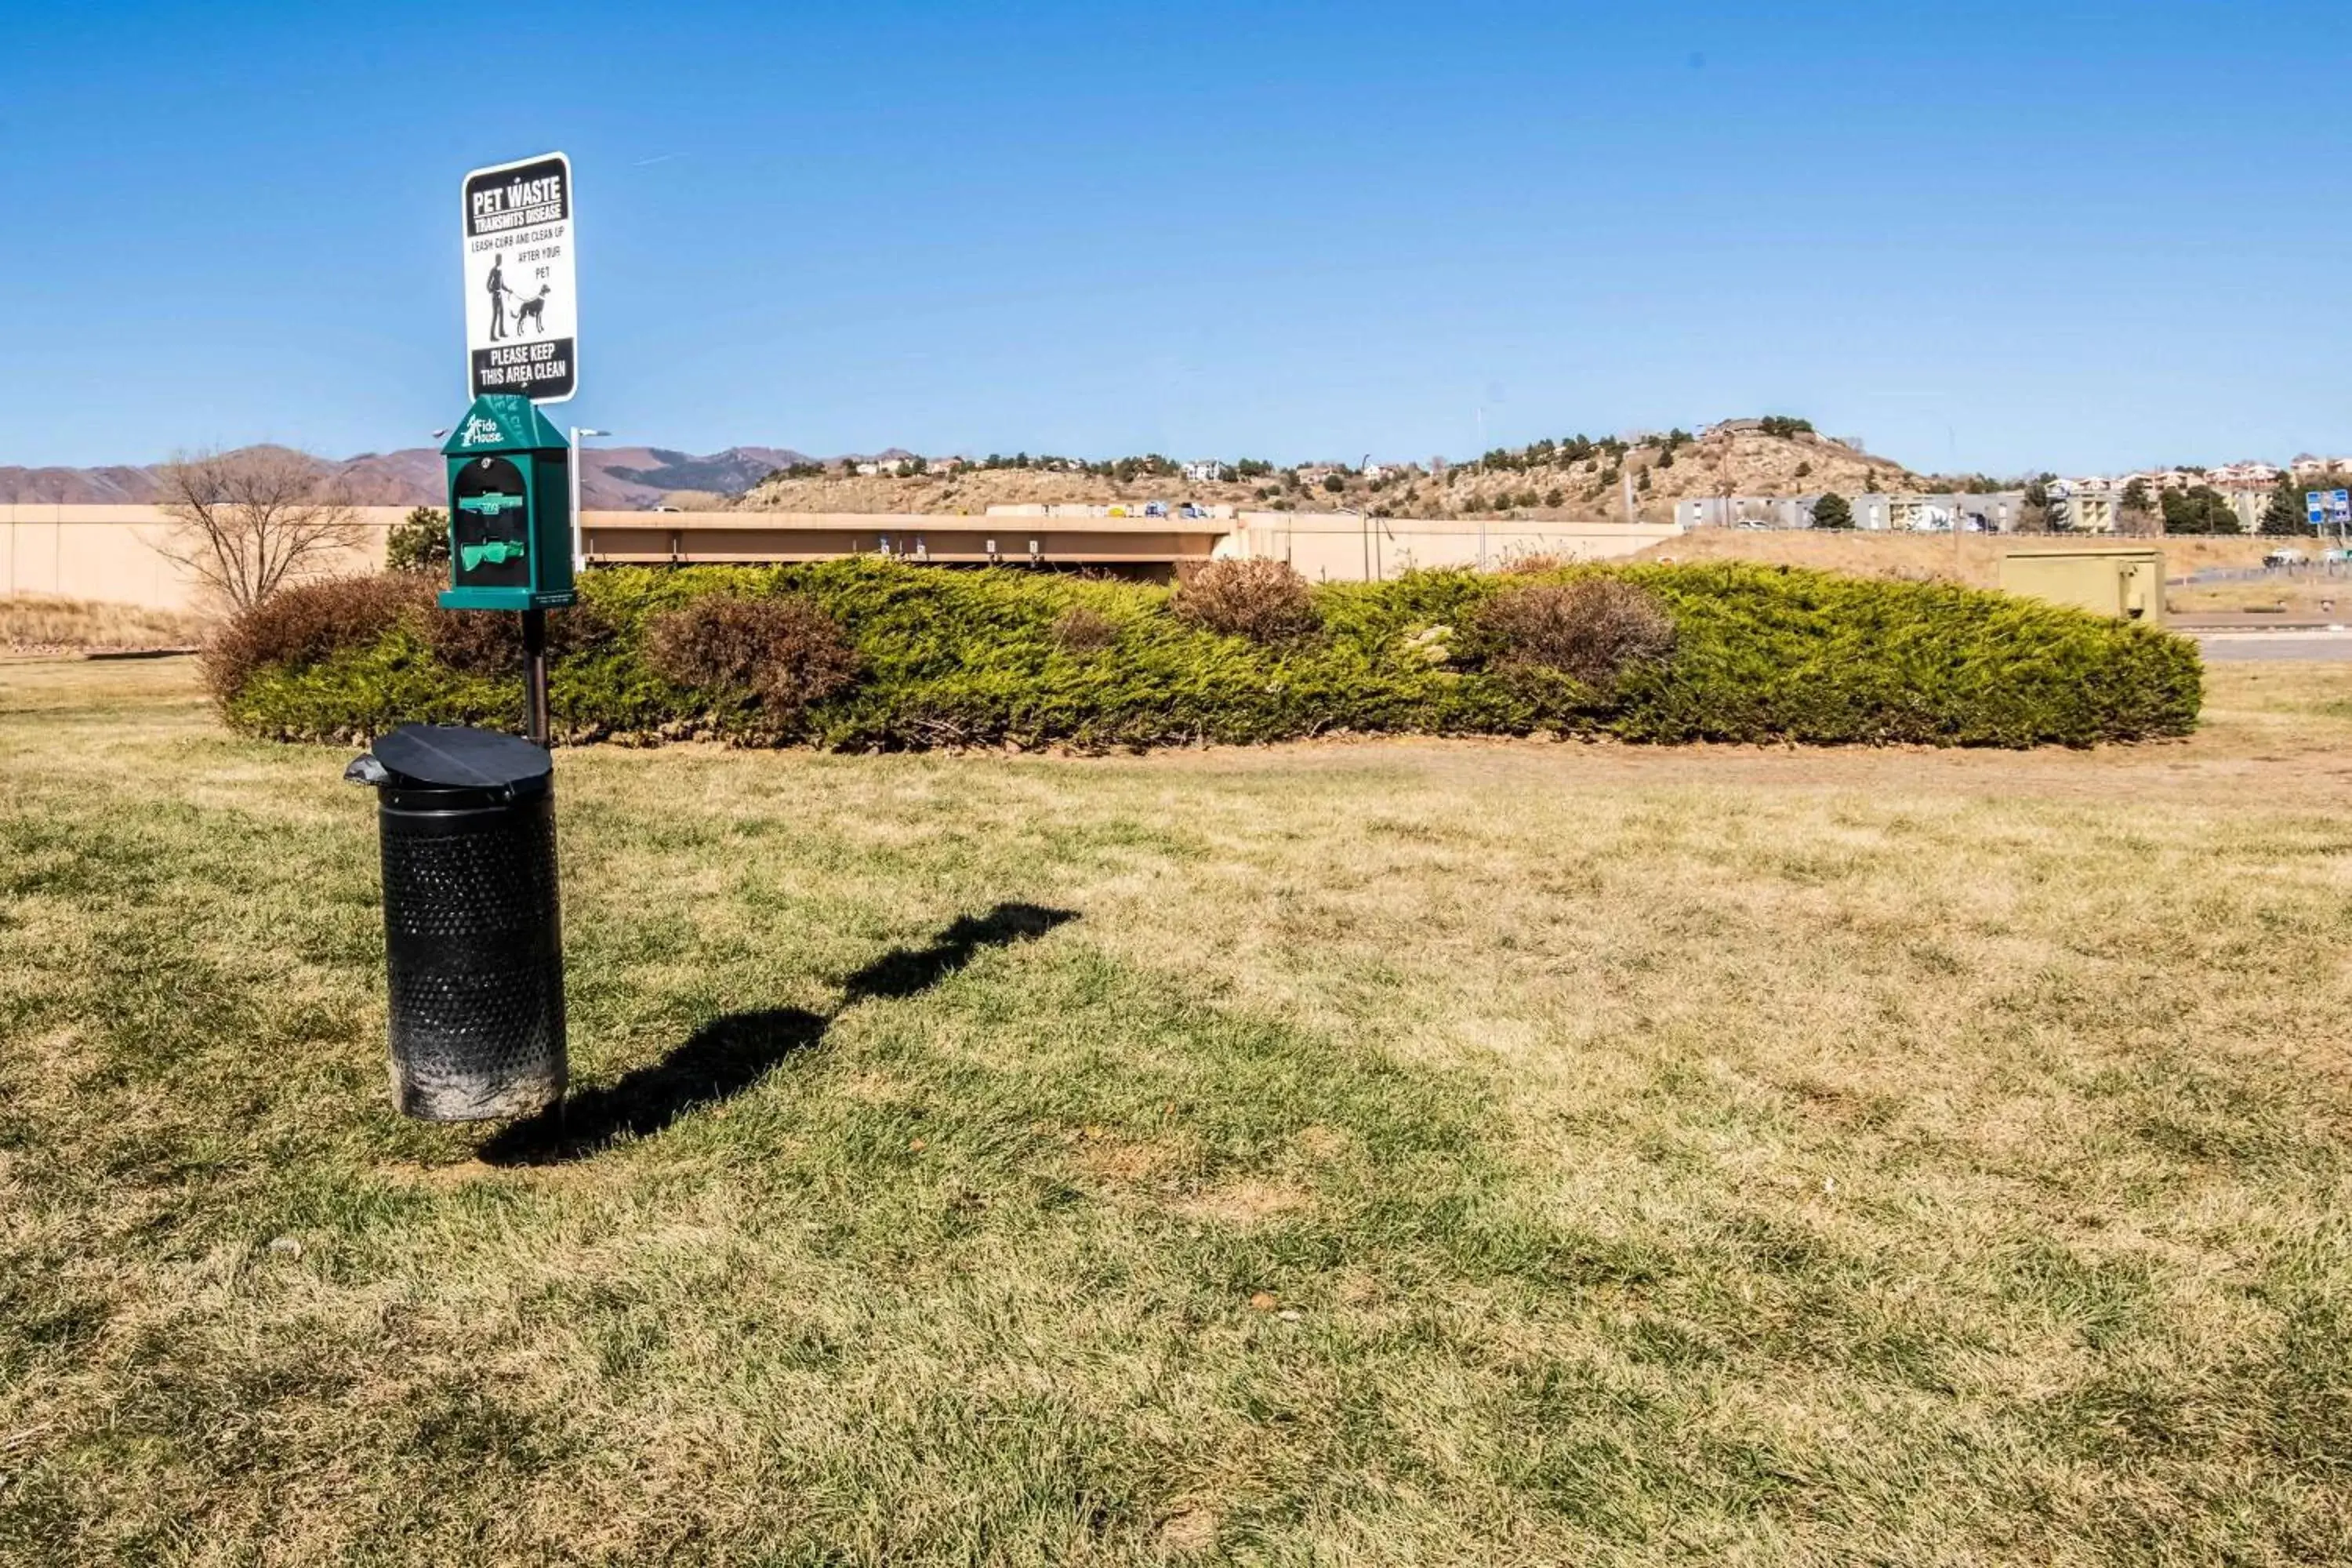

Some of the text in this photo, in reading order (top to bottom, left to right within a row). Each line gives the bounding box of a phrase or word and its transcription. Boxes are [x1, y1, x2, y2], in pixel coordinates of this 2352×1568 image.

[474, 176, 561, 215] PET WASTE
[474, 203, 562, 234] TRANSMITS DISEASE
[472, 225, 564, 252] LEASH CURB AND CLEAN UP
[518, 245, 561, 263] AFTER YOUR
[535, 266, 550, 279] PET
[491, 343, 555, 366] PLEASE KEEP
[481, 360, 566, 386] THIS AREA CLEAN
[477, 418, 497, 431] Fido
[473, 432, 504, 444] House
